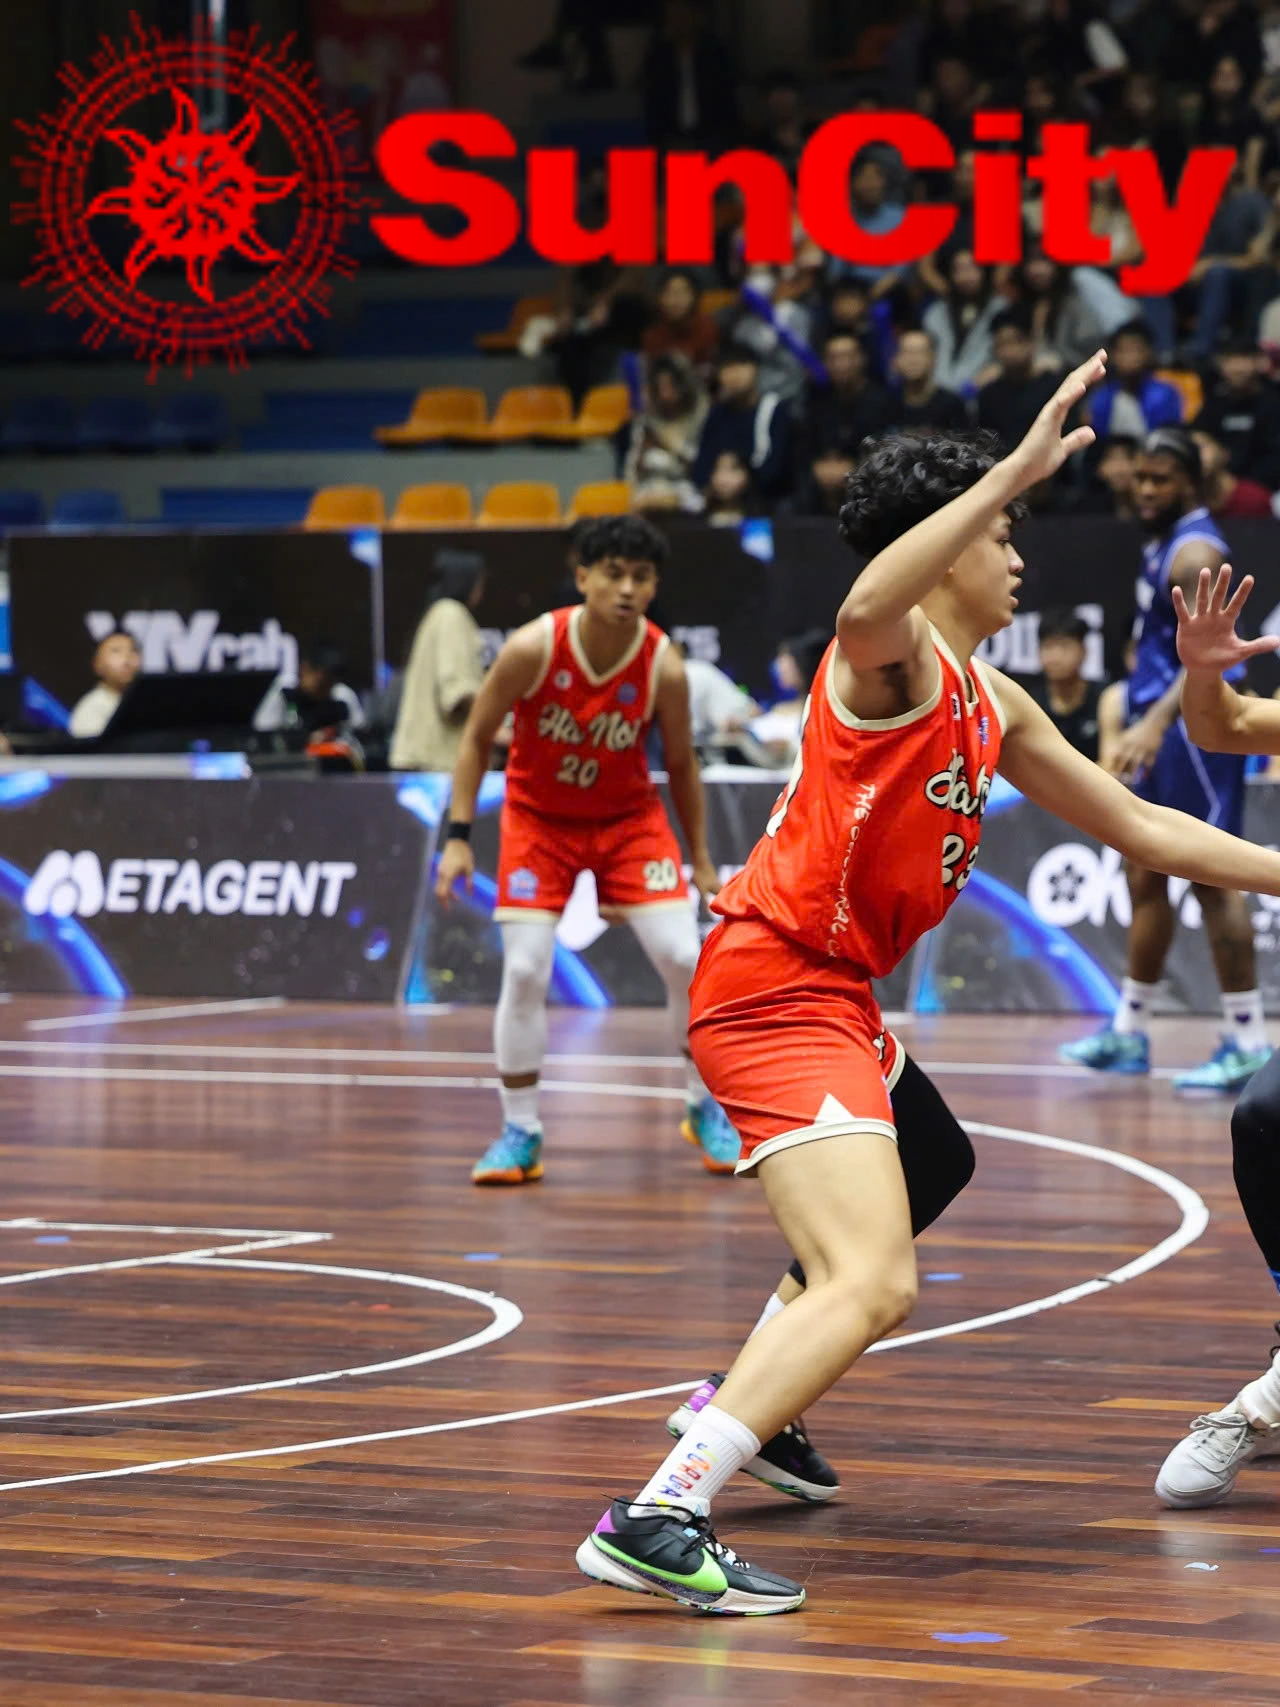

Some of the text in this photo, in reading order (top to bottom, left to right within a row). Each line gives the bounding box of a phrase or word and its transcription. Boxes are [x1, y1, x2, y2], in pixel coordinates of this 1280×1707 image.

[556, 754, 600, 789] 20
[854, 783, 876, 823] THE
[643, 857, 679, 891] 20
